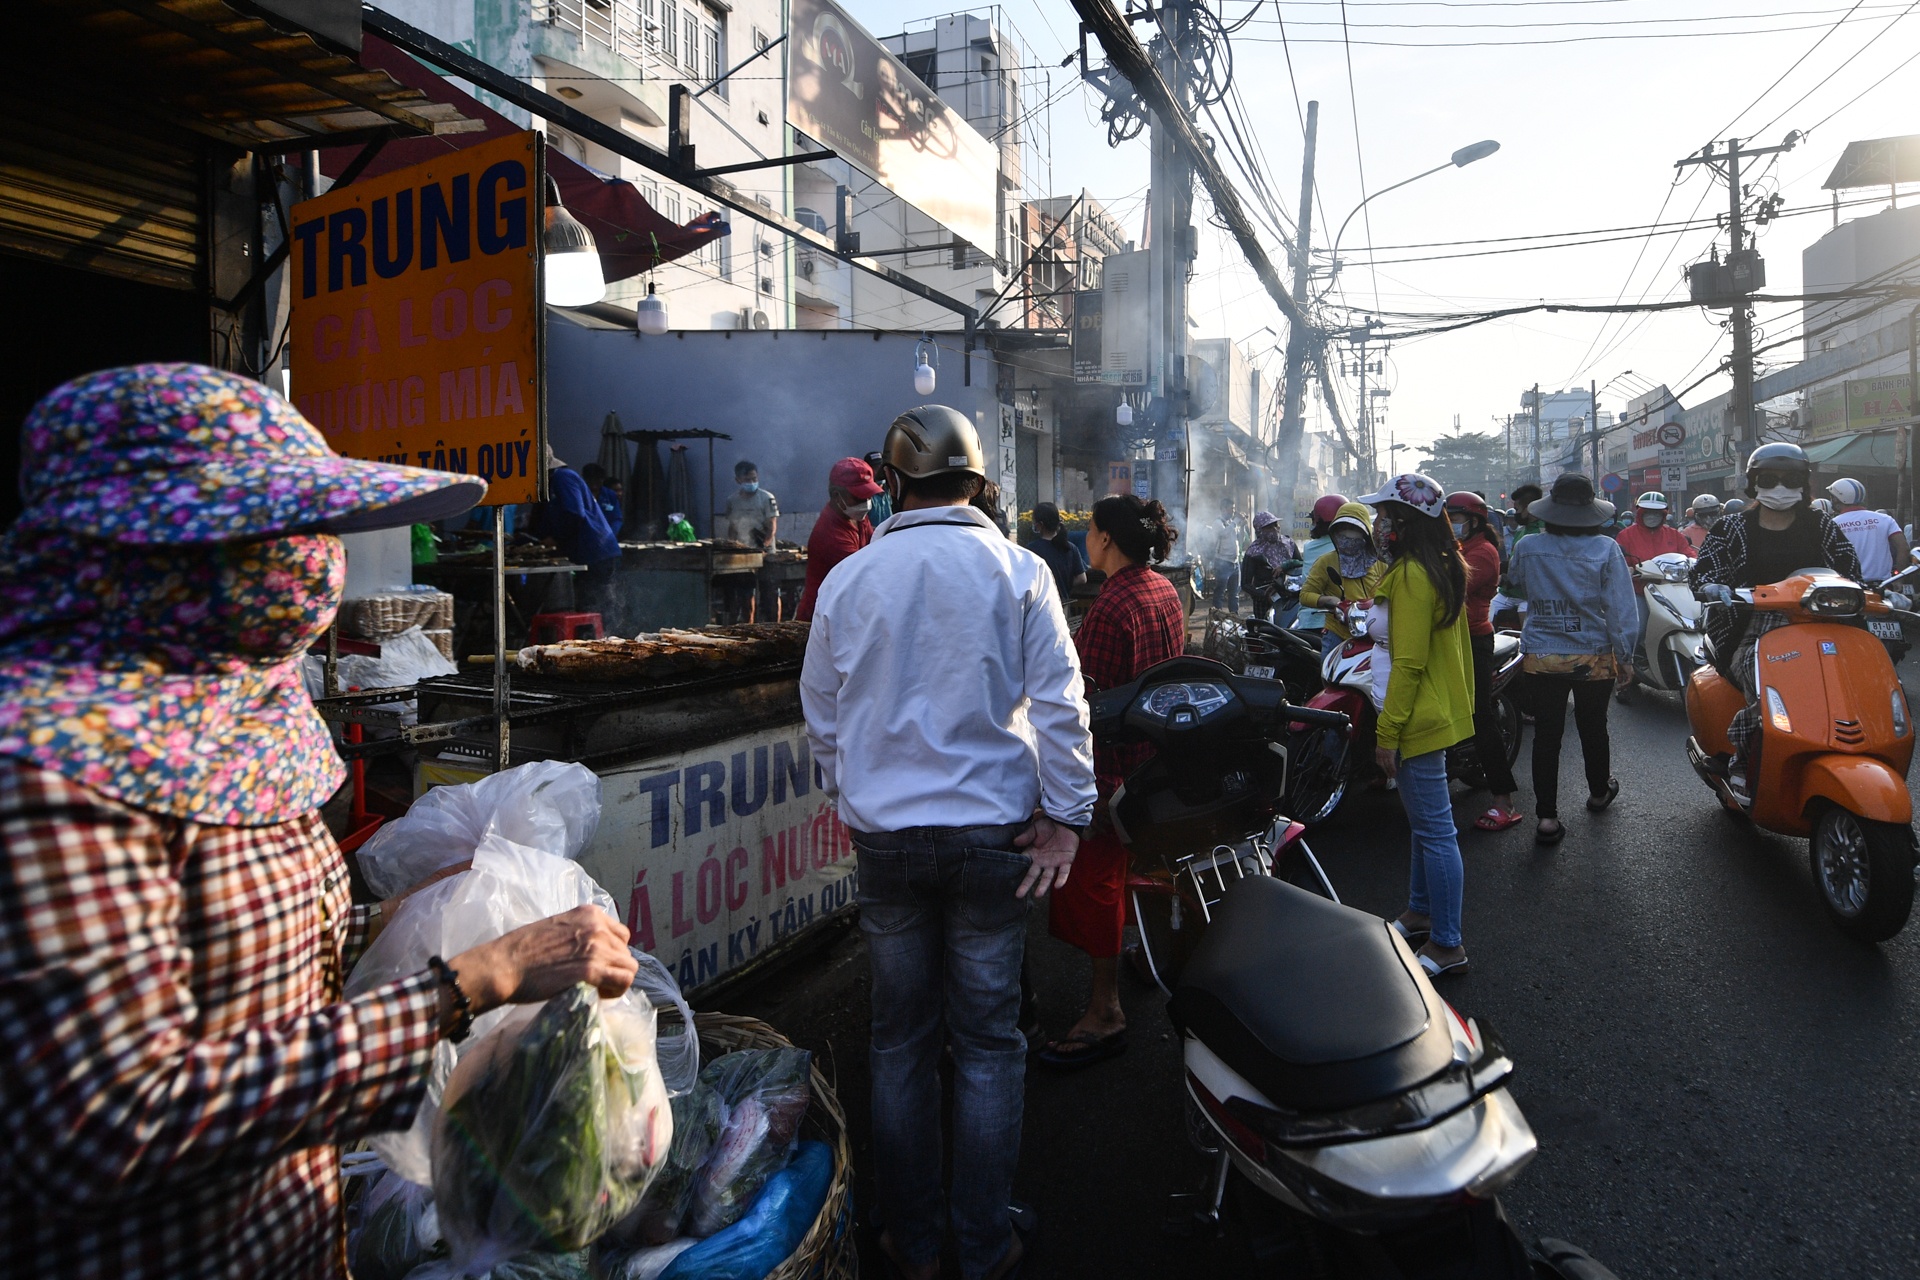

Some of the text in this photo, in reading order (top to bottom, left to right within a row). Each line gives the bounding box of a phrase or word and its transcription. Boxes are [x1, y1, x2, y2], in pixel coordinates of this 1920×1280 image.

[294, 159, 527, 299] TRUNG
[313, 272, 513, 364] CÁ LÓC
[299, 346, 525, 437] NƯỚNG MÍA
[1863, 391, 1910, 416] HẢ
[477, 429, 531, 484] QUÝ
[1863, 518, 1880, 526] JSC
[1872, 622, 1896, 631] 81-U1
[639, 735, 823, 850] TRUN
[614, 802, 854, 953] Á LÓC NƯỚN
[727, 915, 761, 968] KỲ
[769, 895, 814, 943] TÂN
[820, 866, 859, 917] QUÝ
